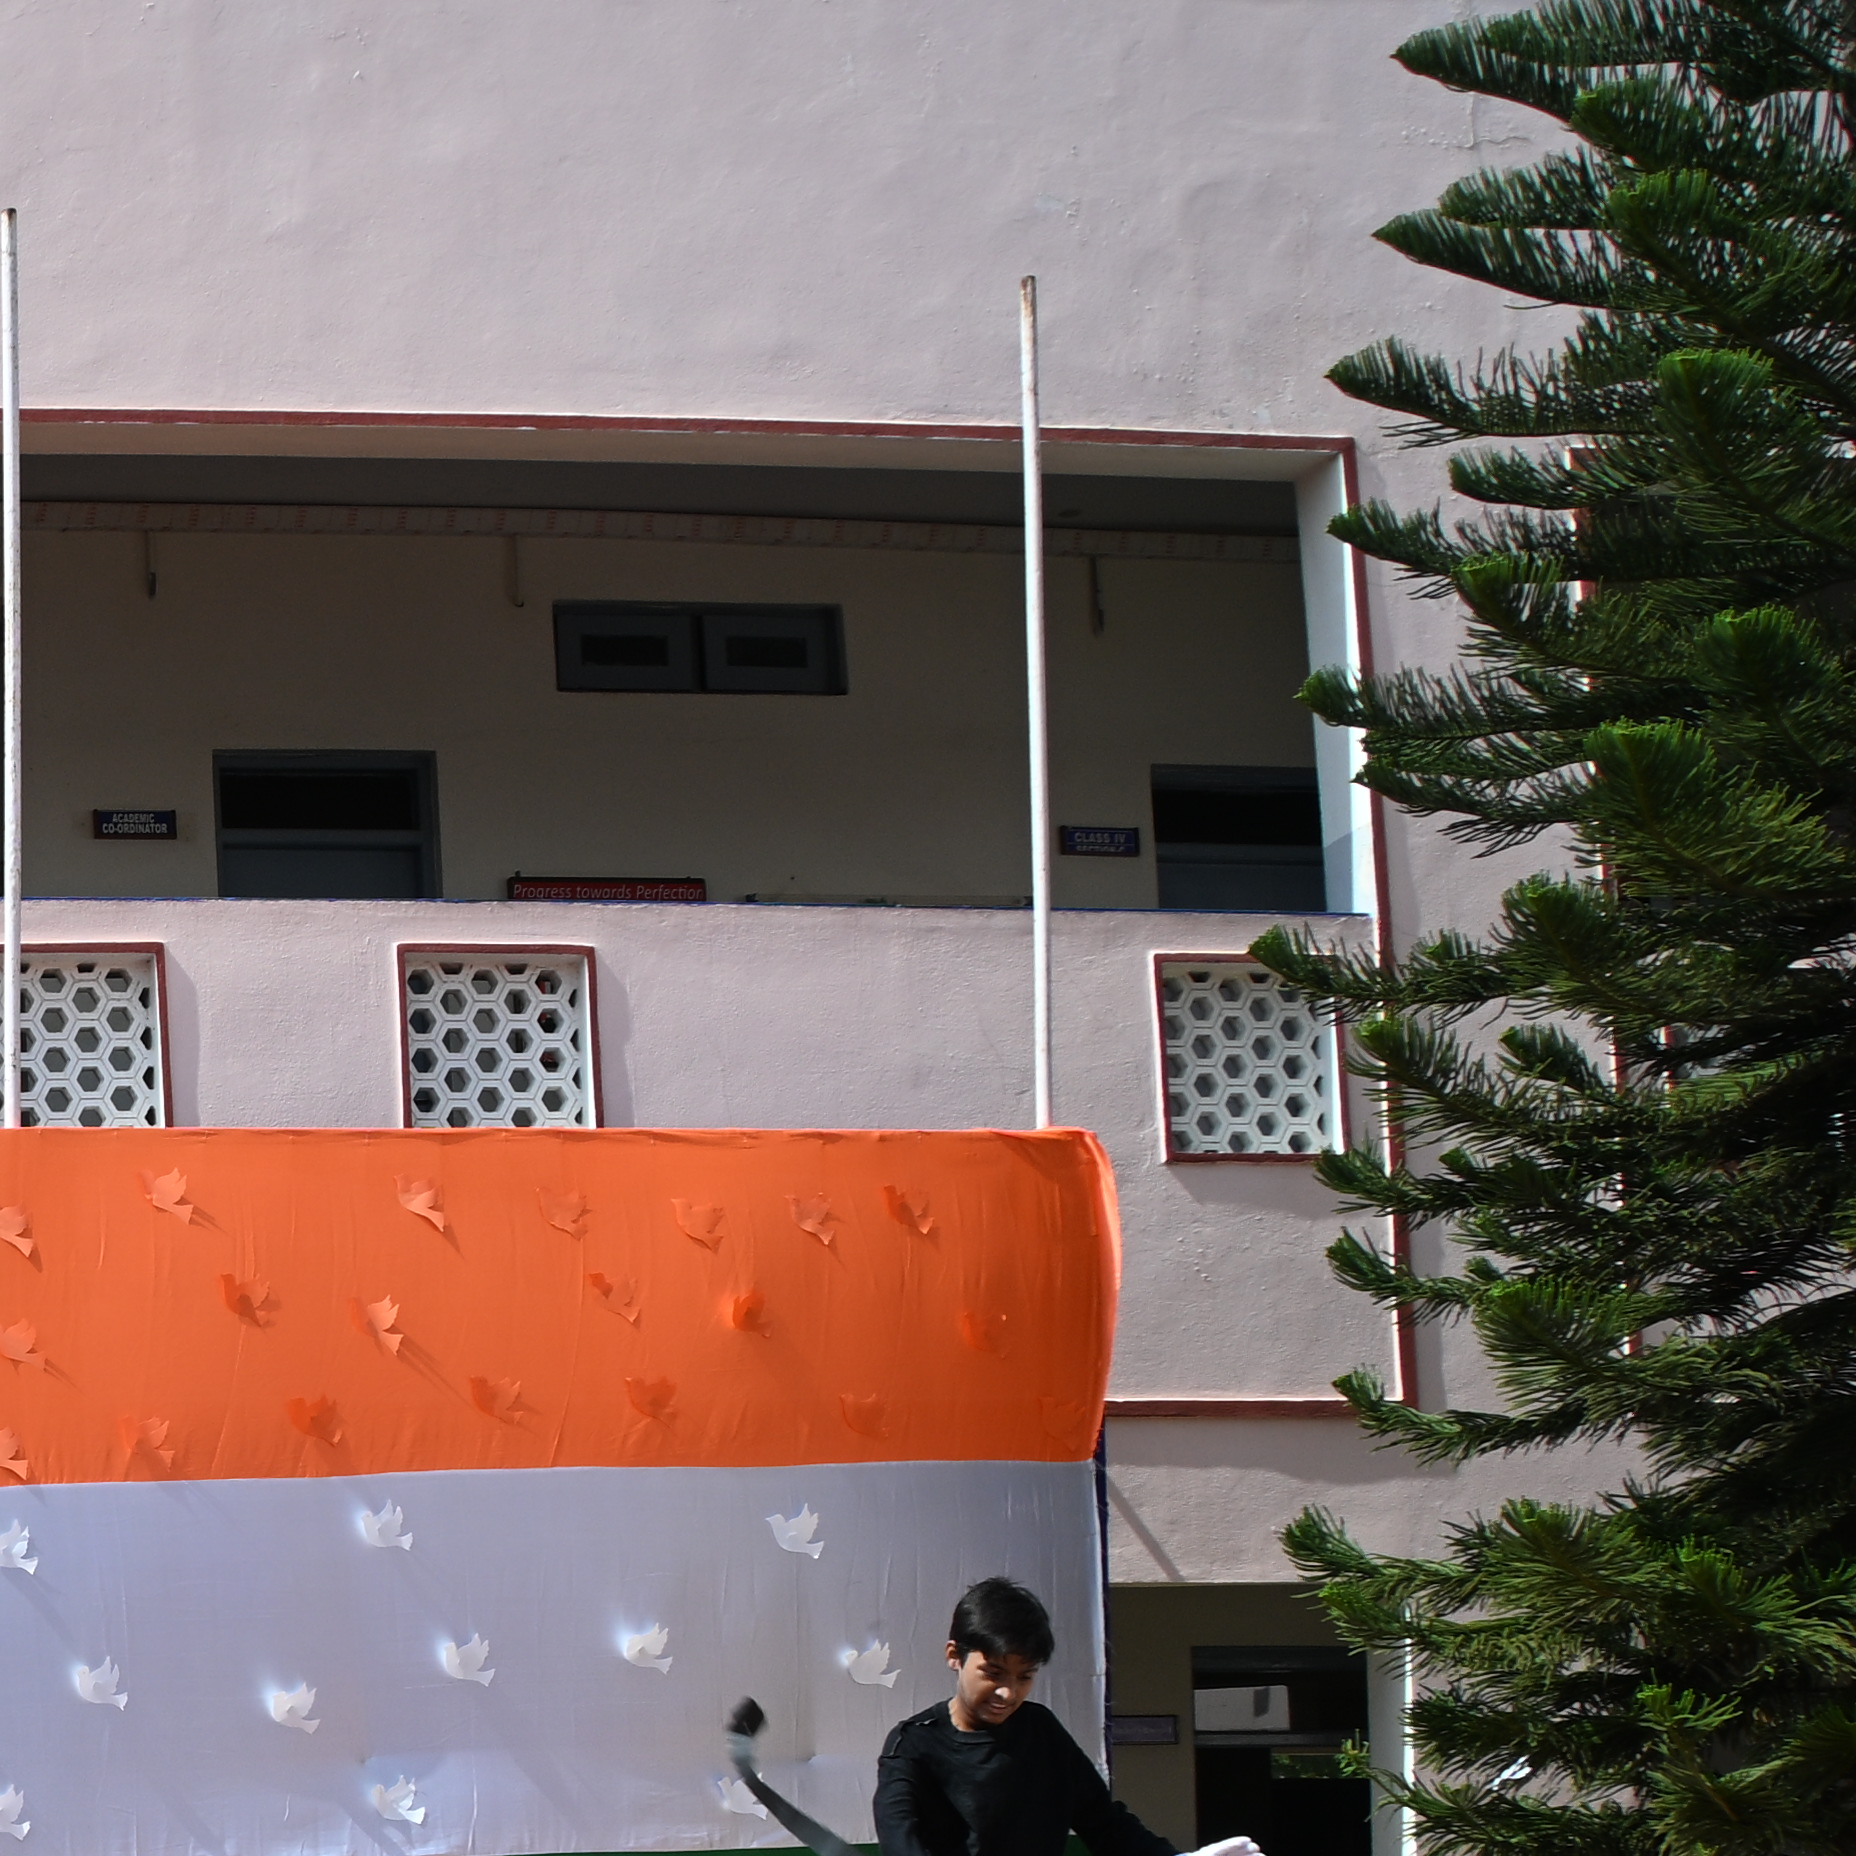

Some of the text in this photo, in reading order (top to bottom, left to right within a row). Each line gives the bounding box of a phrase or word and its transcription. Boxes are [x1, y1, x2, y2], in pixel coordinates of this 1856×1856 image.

[112, 813, 155, 823] ACADEMIC
[102, 823, 168, 834] CO-ORDINATOR
[1074, 832, 1111, 844] CLASS
[513, 884, 704, 900] Progress towards Perfection
